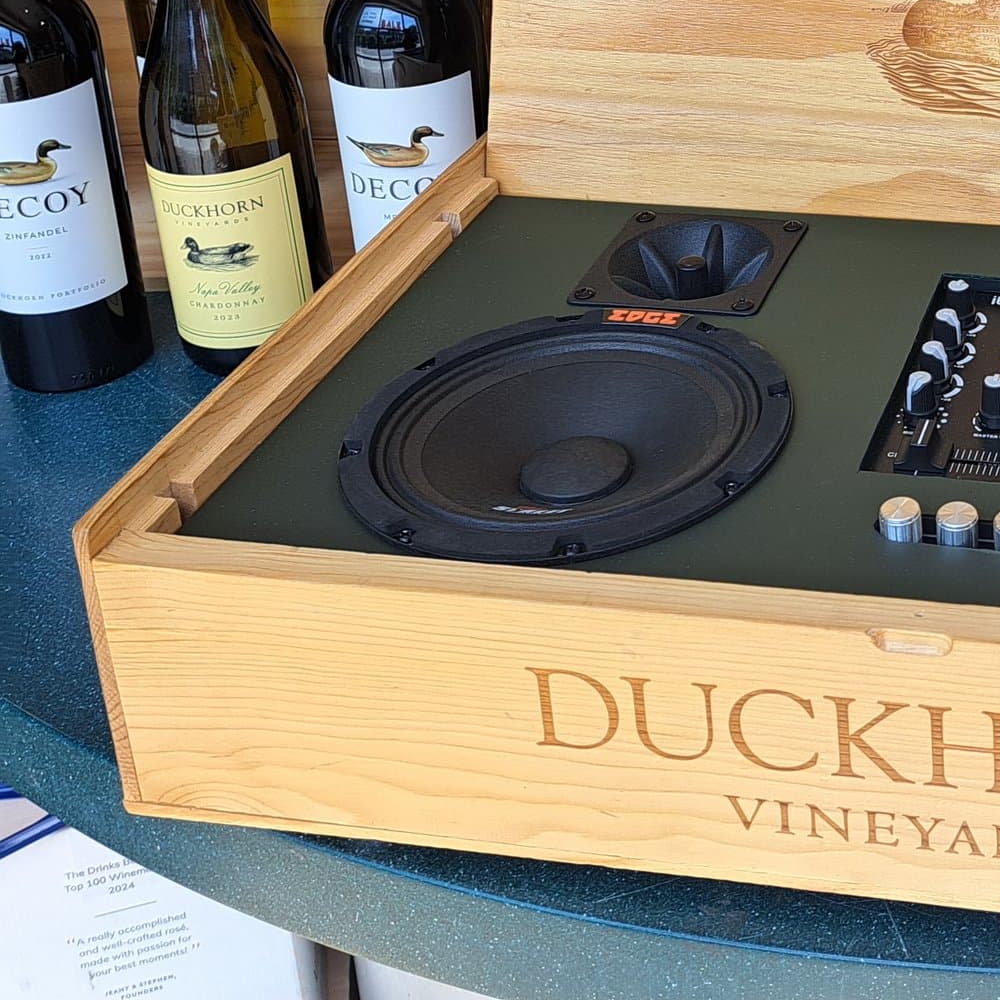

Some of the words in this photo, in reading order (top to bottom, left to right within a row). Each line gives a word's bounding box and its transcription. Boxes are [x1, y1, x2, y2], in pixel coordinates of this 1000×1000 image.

[162, 195, 265, 218] DUCKHORN
[176, 217, 249, 227] VINEYARDS
[5, 226, 69, 241] ZINFANDEL
[51, 278, 107, 299] PORTFOLIO
[189, 281, 219, 297] Napa
[219, 280, 262, 295] Valley
[189, 296, 266, 310] CHARDONNAY
[65, 869, 85, 881] The
[87, 860, 121, 875] Drinks
[64, 882, 84, 894] Top
[86, 876, 107, 888] 100
[108, 881, 136, 895] 2024
[87, 929, 116, 944] really
[117, 911, 187, 936] accomplished
[79, 945, 99, 957] and
[101, 929, 163, 952] well-crafted
[80, 955, 110, 969] made
[111, 948, 135, 962] with
[136, 939, 176, 956] passion
[177, 934, 192, 948] for
[88, 967, 113, 981] your
[114, 960, 138, 973] best
